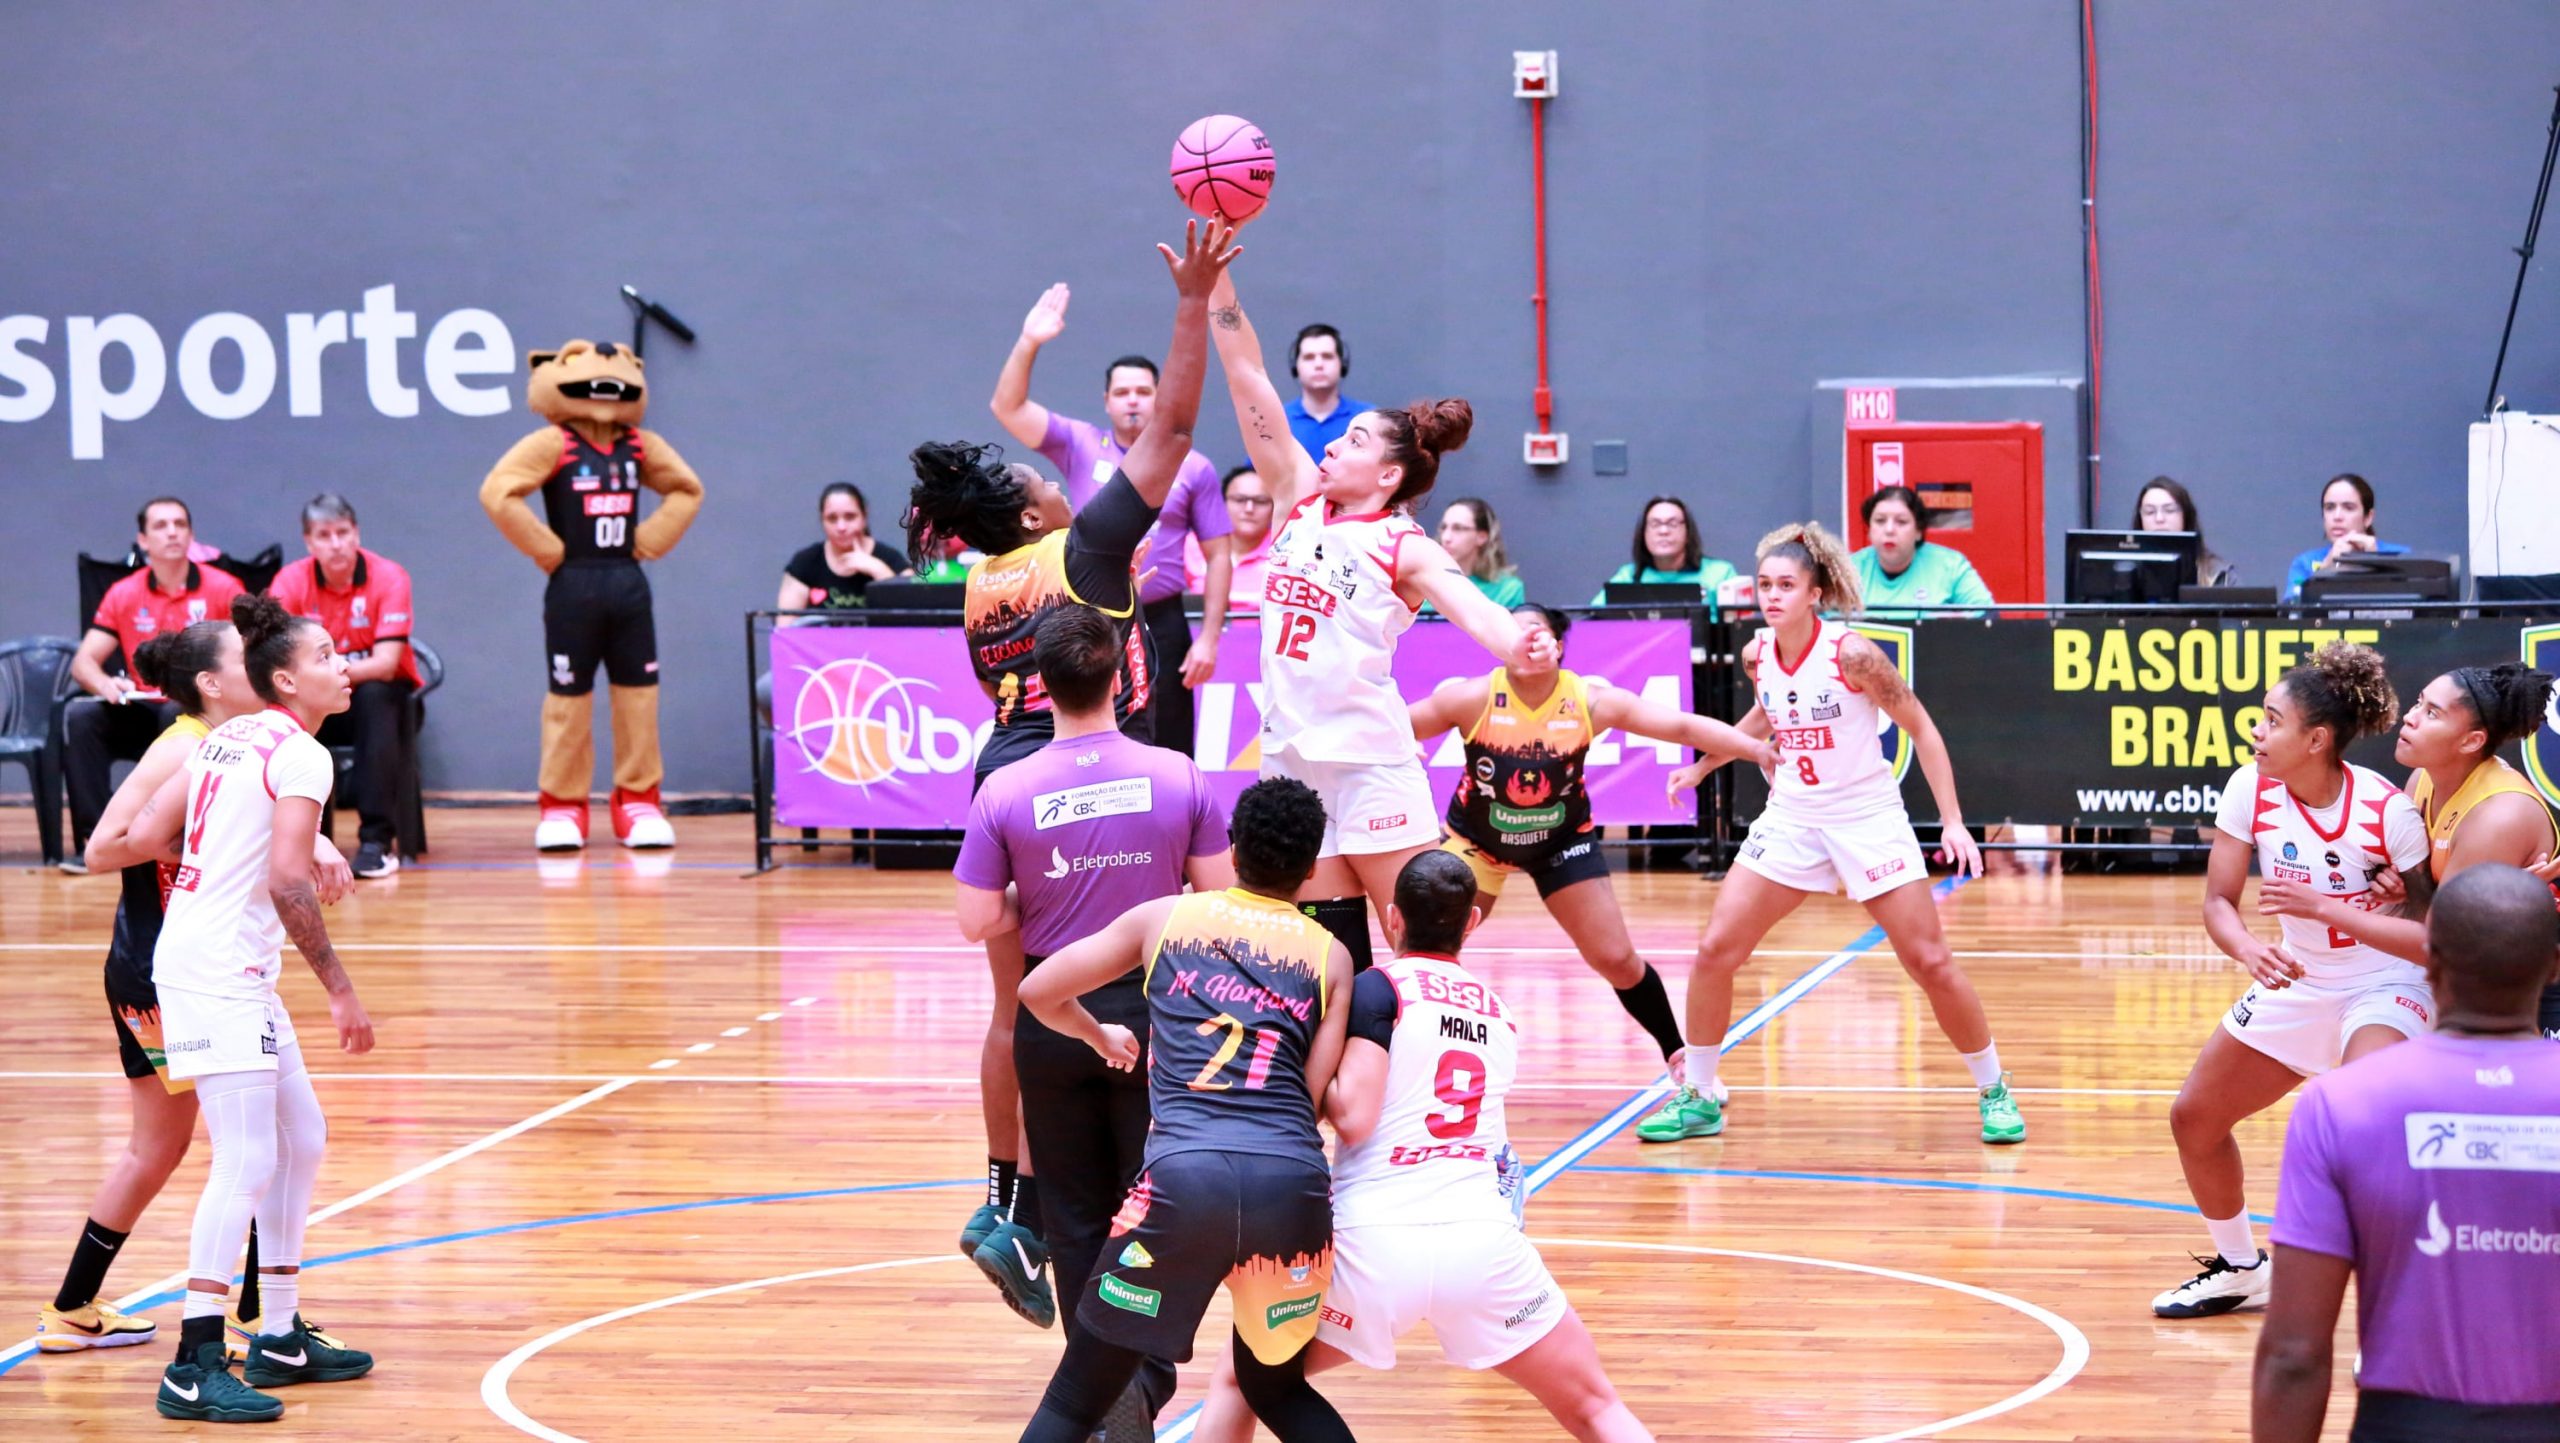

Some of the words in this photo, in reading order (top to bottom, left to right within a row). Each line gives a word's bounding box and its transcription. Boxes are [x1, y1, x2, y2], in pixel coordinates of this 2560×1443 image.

[1851, 391, 1889, 420] H10
[595, 516, 627, 548] 00
[1269, 577, 1331, 614] SESI
[1275, 611, 1317, 662] 12
[2053, 628, 2380, 695] BASQUE
[1780, 729, 1825, 750] SESI
[1796, 755, 1820, 786] 8
[1073, 801, 1097, 815] CBC
[1495, 808, 1560, 825] Unimed
[1372, 815, 1405, 830] FIESP
[1500, 829, 1549, 846] BASQUETE
[1073, 850, 1152, 872] Eletrobras
[1562, 842, 1591, 860] MRV
[1868, 860, 1903, 882] FIESP
[2273, 857, 2310, 870] Araraquara
[2276, 868, 2308, 882] FIESP
[1428, 974, 1492, 1014] SESI
[1439, 1014, 1488, 1045] MAILA
[1187, 1012, 1281, 1091] 21
[1424, 1049, 1486, 1139] 9
[1104, 1278, 1154, 1305] Unimed
[1271, 1297, 1317, 1319] Unimed
